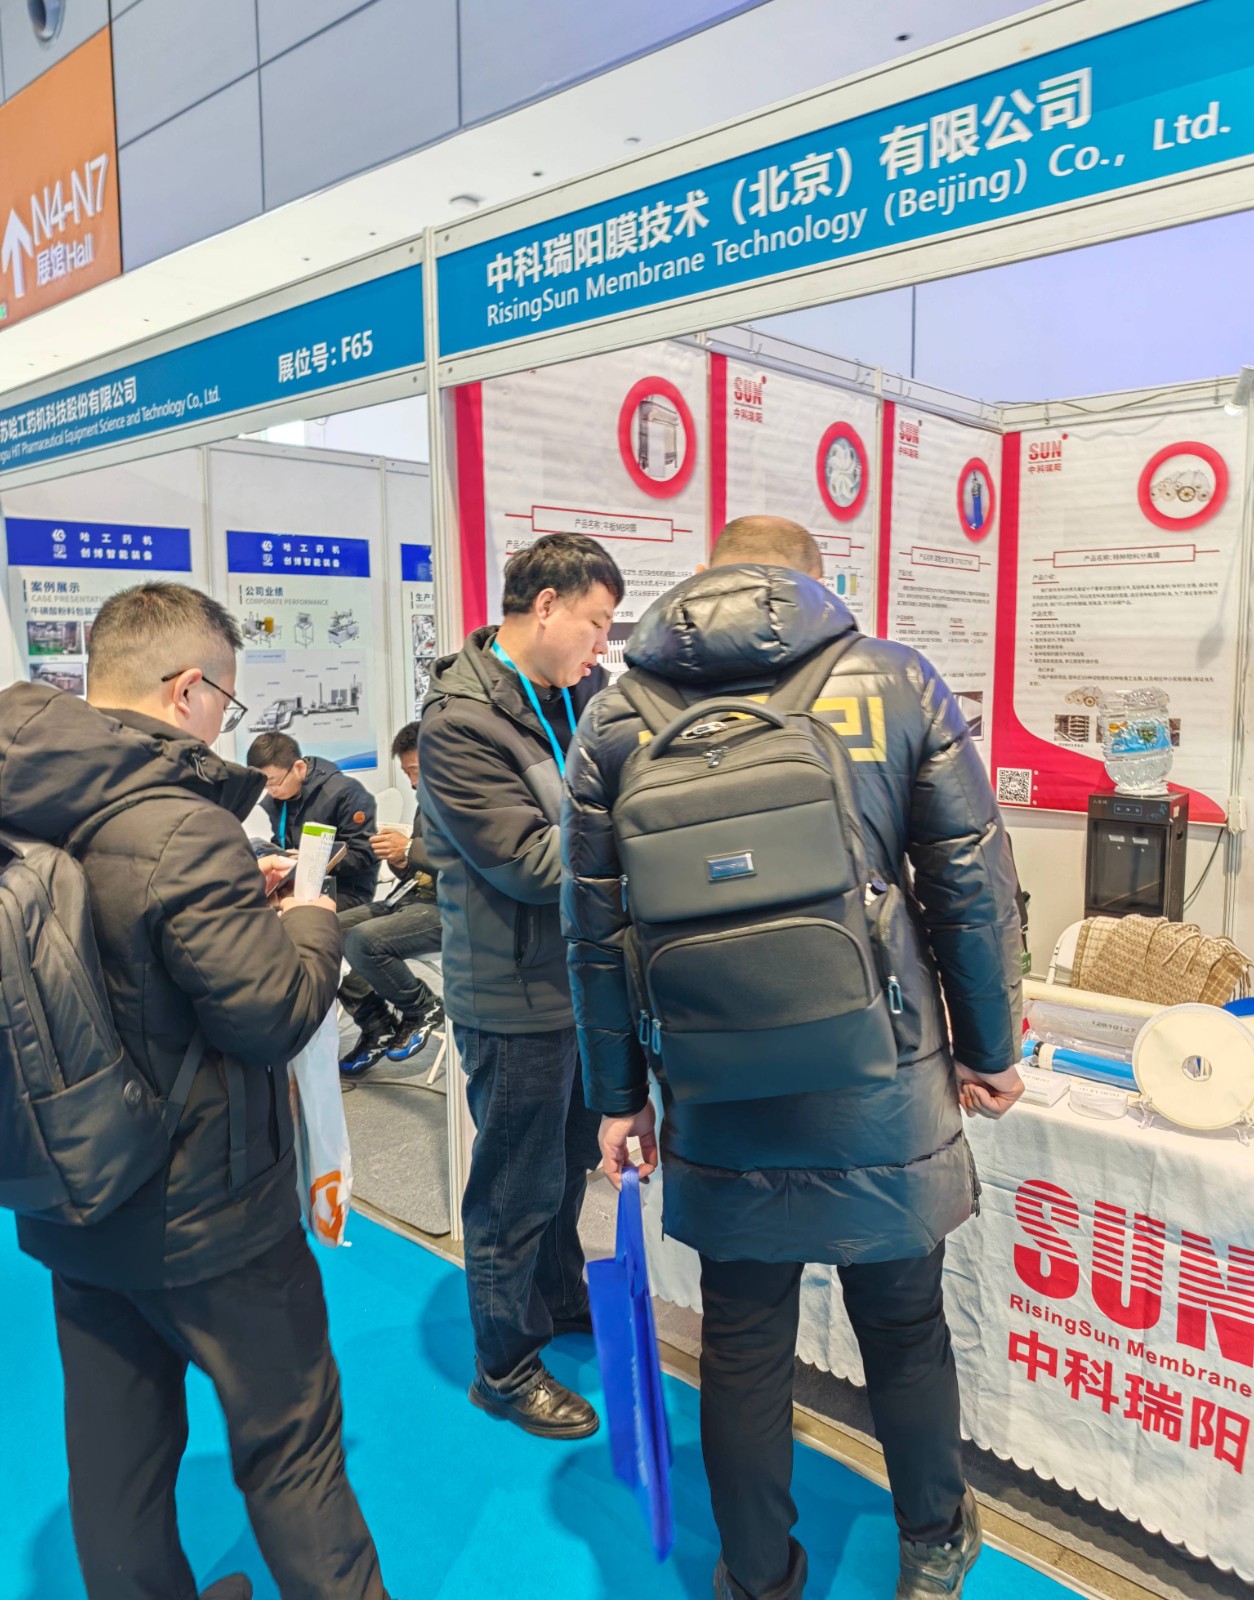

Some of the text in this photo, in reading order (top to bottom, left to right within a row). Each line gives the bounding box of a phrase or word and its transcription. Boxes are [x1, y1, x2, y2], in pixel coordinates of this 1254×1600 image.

[30, 152, 109, 247] N4-N7
[487, 101, 1232, 327] RisingSun Membrane Technology (Beijing) Co., Ltd.
[341, 329, 373, 363] F65
[21, 429, 64, 455] Pharmaceutical
[64, 421, 99, 446] Equipment
[99, 415, 126, 434] Science
[126, 406, 141, 427] and
[141, 397, 186, 422] Technology
[1028, 440, 1062, 460] SUN
[31, 581, 80, 594] 案例展示
[31, 594, 52, 603] CASE
[245, 586, 284, 597] 公司业绩
[1013, 1179, 1254, 1369] SUN
[1009, 1293, 1253, 1398] RisingSun Membrane
[1007, 1329, 1251, 1475] 中科瑞阳
